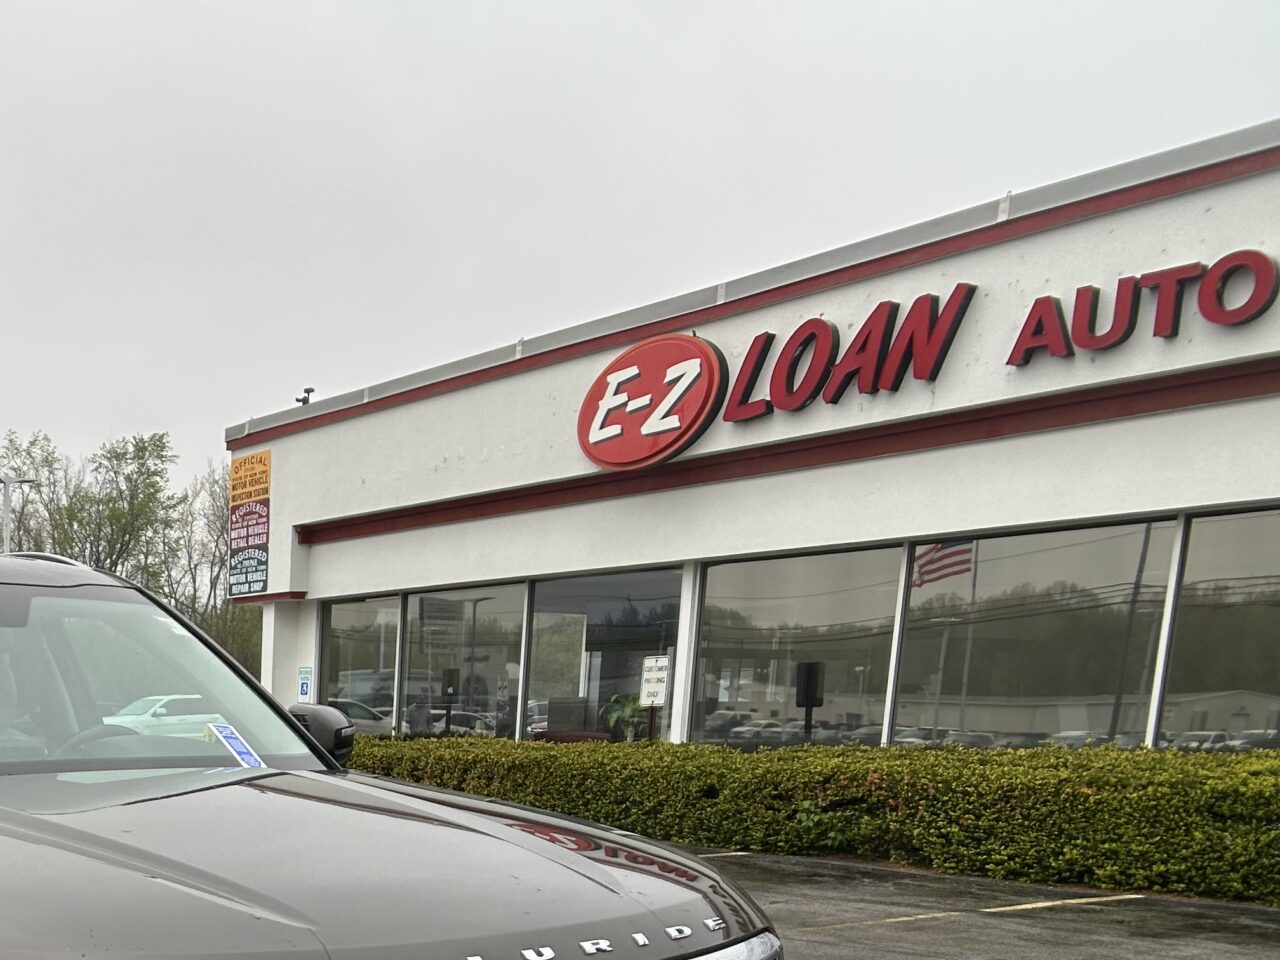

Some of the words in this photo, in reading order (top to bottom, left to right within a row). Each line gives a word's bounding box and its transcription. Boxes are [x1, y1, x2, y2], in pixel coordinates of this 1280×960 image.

[588, 357, 702, 444] E-Z
[722, 282, 978, 423] LOAN
[1006, 249, 1279, 367] AUTO
[234, 455, 268, 474] OFFICIAL
[232, 480, 248, 492] MOTOR
[249, 474, 269, 488] VEHICLE
[232, 502, 268, 522] REGISTERED
[231, 527, 248, 540] MOTOR
[248, 522, 268, 536] VEHICLE
[231, 537, 248, 549] RETAIL
[248, 533, 267, 546] DEALER
[231, 549, 267, 567] REGISTERED
[230, 573, 246, 585] MOTOR
[247, 570, 267, 582] VEHICLE
[231, 583, 249, 594] REPAIR
[250, 581, 264, 592] SHOP
